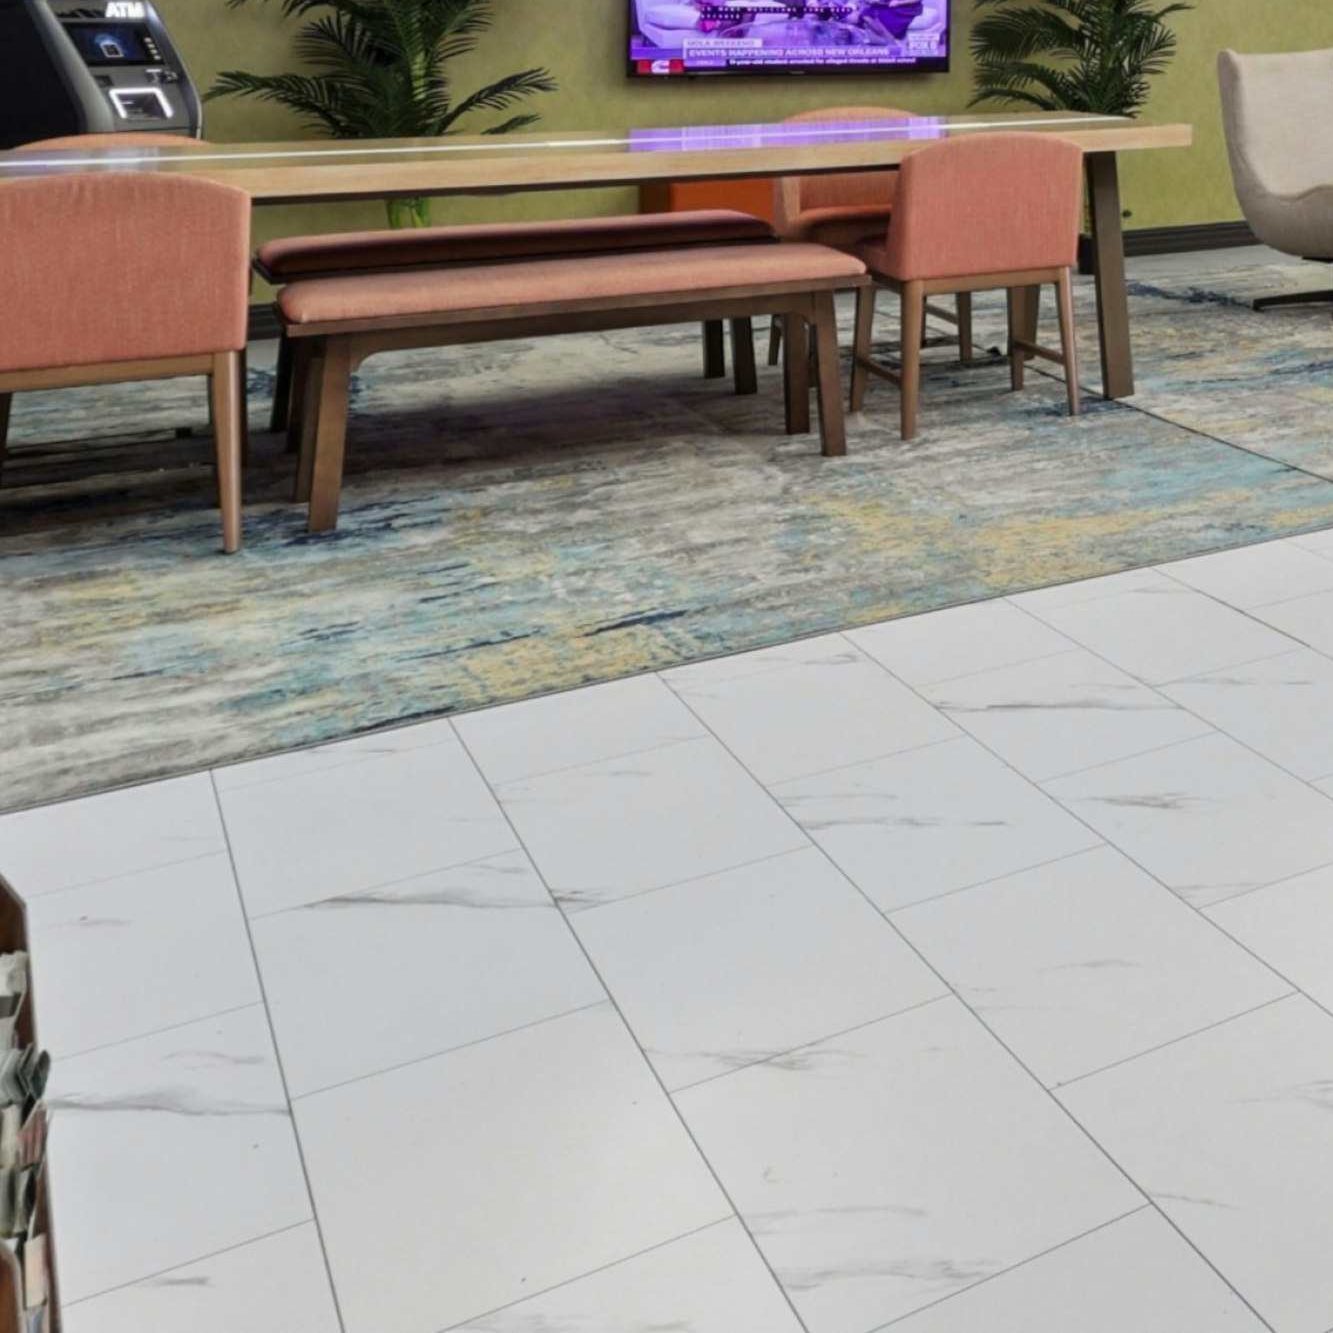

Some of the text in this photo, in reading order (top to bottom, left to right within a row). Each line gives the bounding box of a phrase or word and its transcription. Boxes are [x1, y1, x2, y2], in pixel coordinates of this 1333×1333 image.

[105, 1, 145, 18] ATM
[688, 48, 890, 57] EVENTS HAPPENING ACROSS NEW ORLEANS
